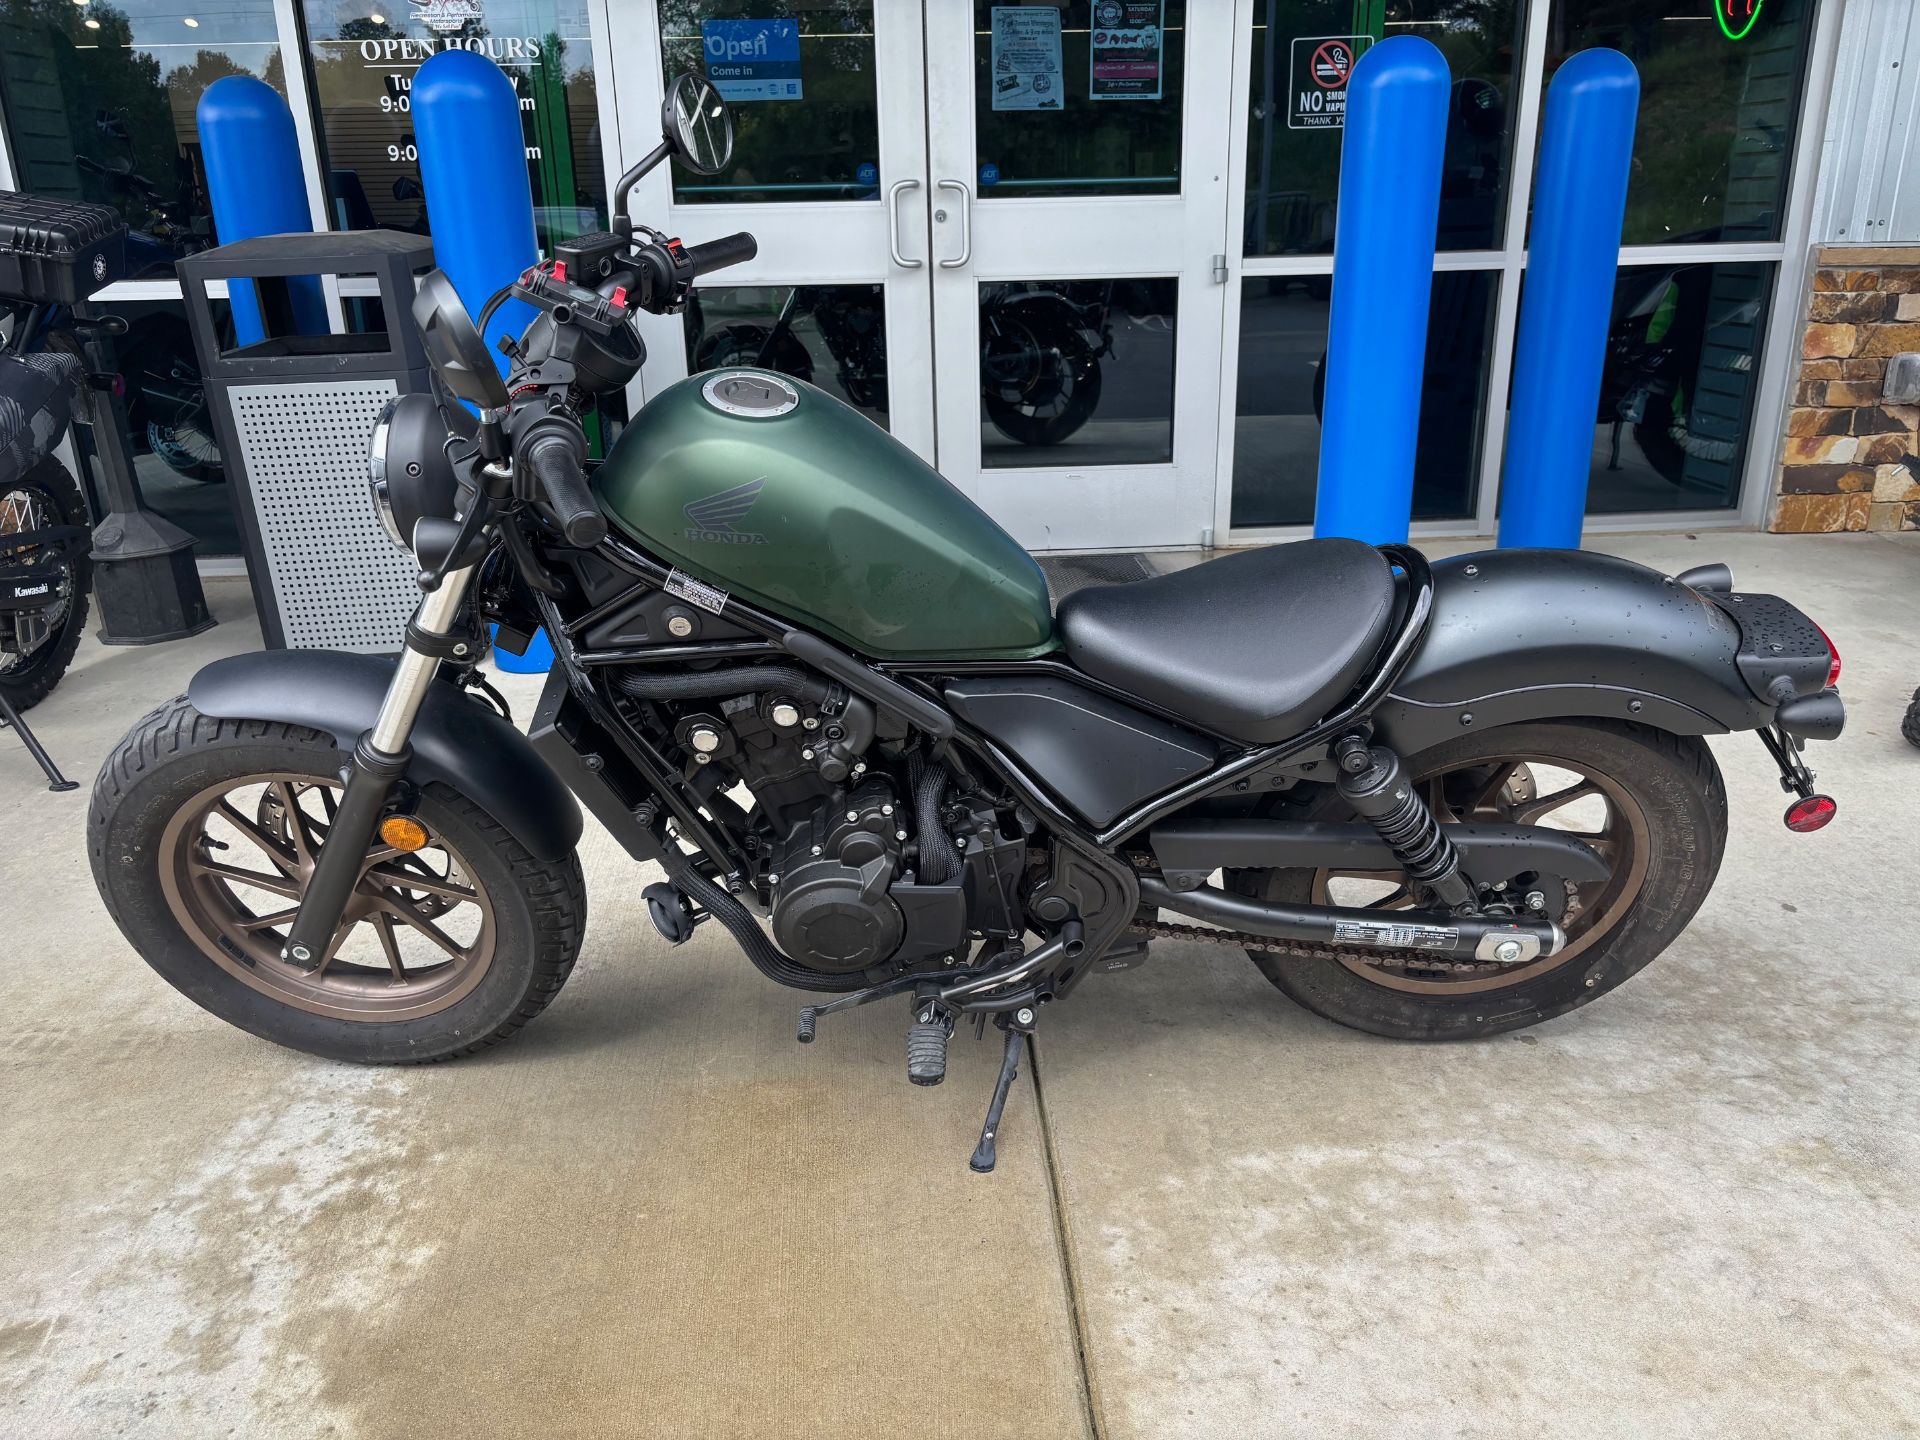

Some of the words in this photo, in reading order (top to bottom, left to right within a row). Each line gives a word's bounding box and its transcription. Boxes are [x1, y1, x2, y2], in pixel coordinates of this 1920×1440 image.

[360, 38, 436, 61] OPEN
[708, 36, 767, 60] Open
[711, 66, 741, 76] Come
[743, 65, 753, 76] in
[1300, 91, 1323, 112] NO
[1303, 116, 1332, 126] THANK
[685, 528, 769, 545] HONDA
[14, 583, 49, 598] Kawasaki
